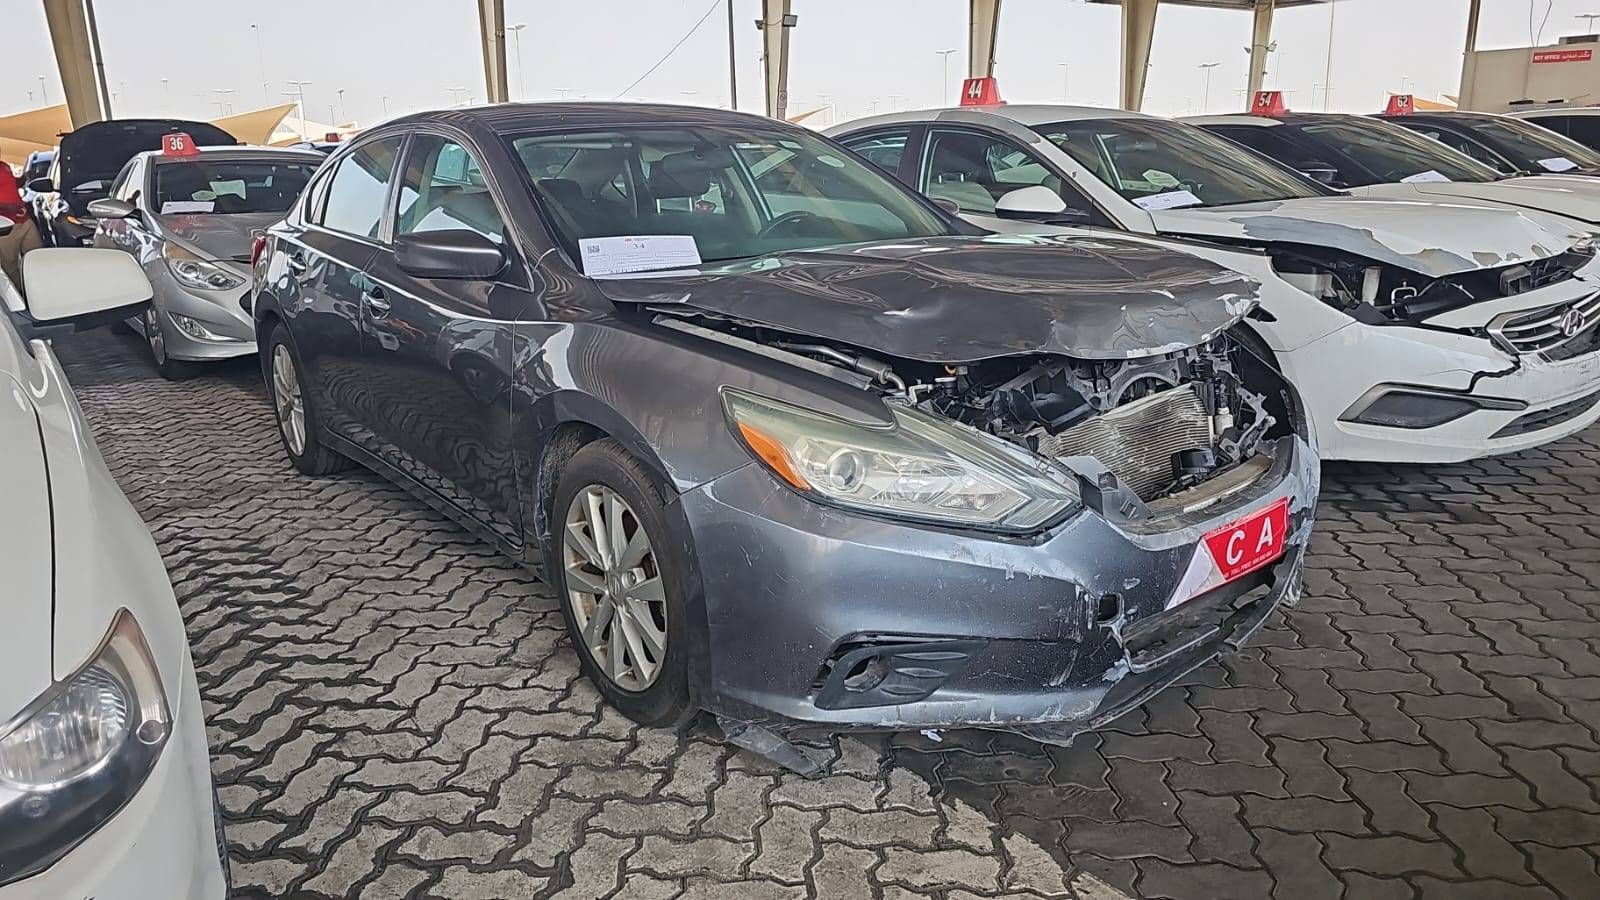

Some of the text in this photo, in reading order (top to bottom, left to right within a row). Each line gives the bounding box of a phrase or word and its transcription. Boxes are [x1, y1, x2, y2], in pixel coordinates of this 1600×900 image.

[968, 80, 983, 98] 44
[1258, 92, 1273, 107] 54
[1397, 96, 1409, 108] 62
[169, 136, 184, 151] 36
[1226, 529, 1246, 566] C
[1255, 516, 1273, 553] A
